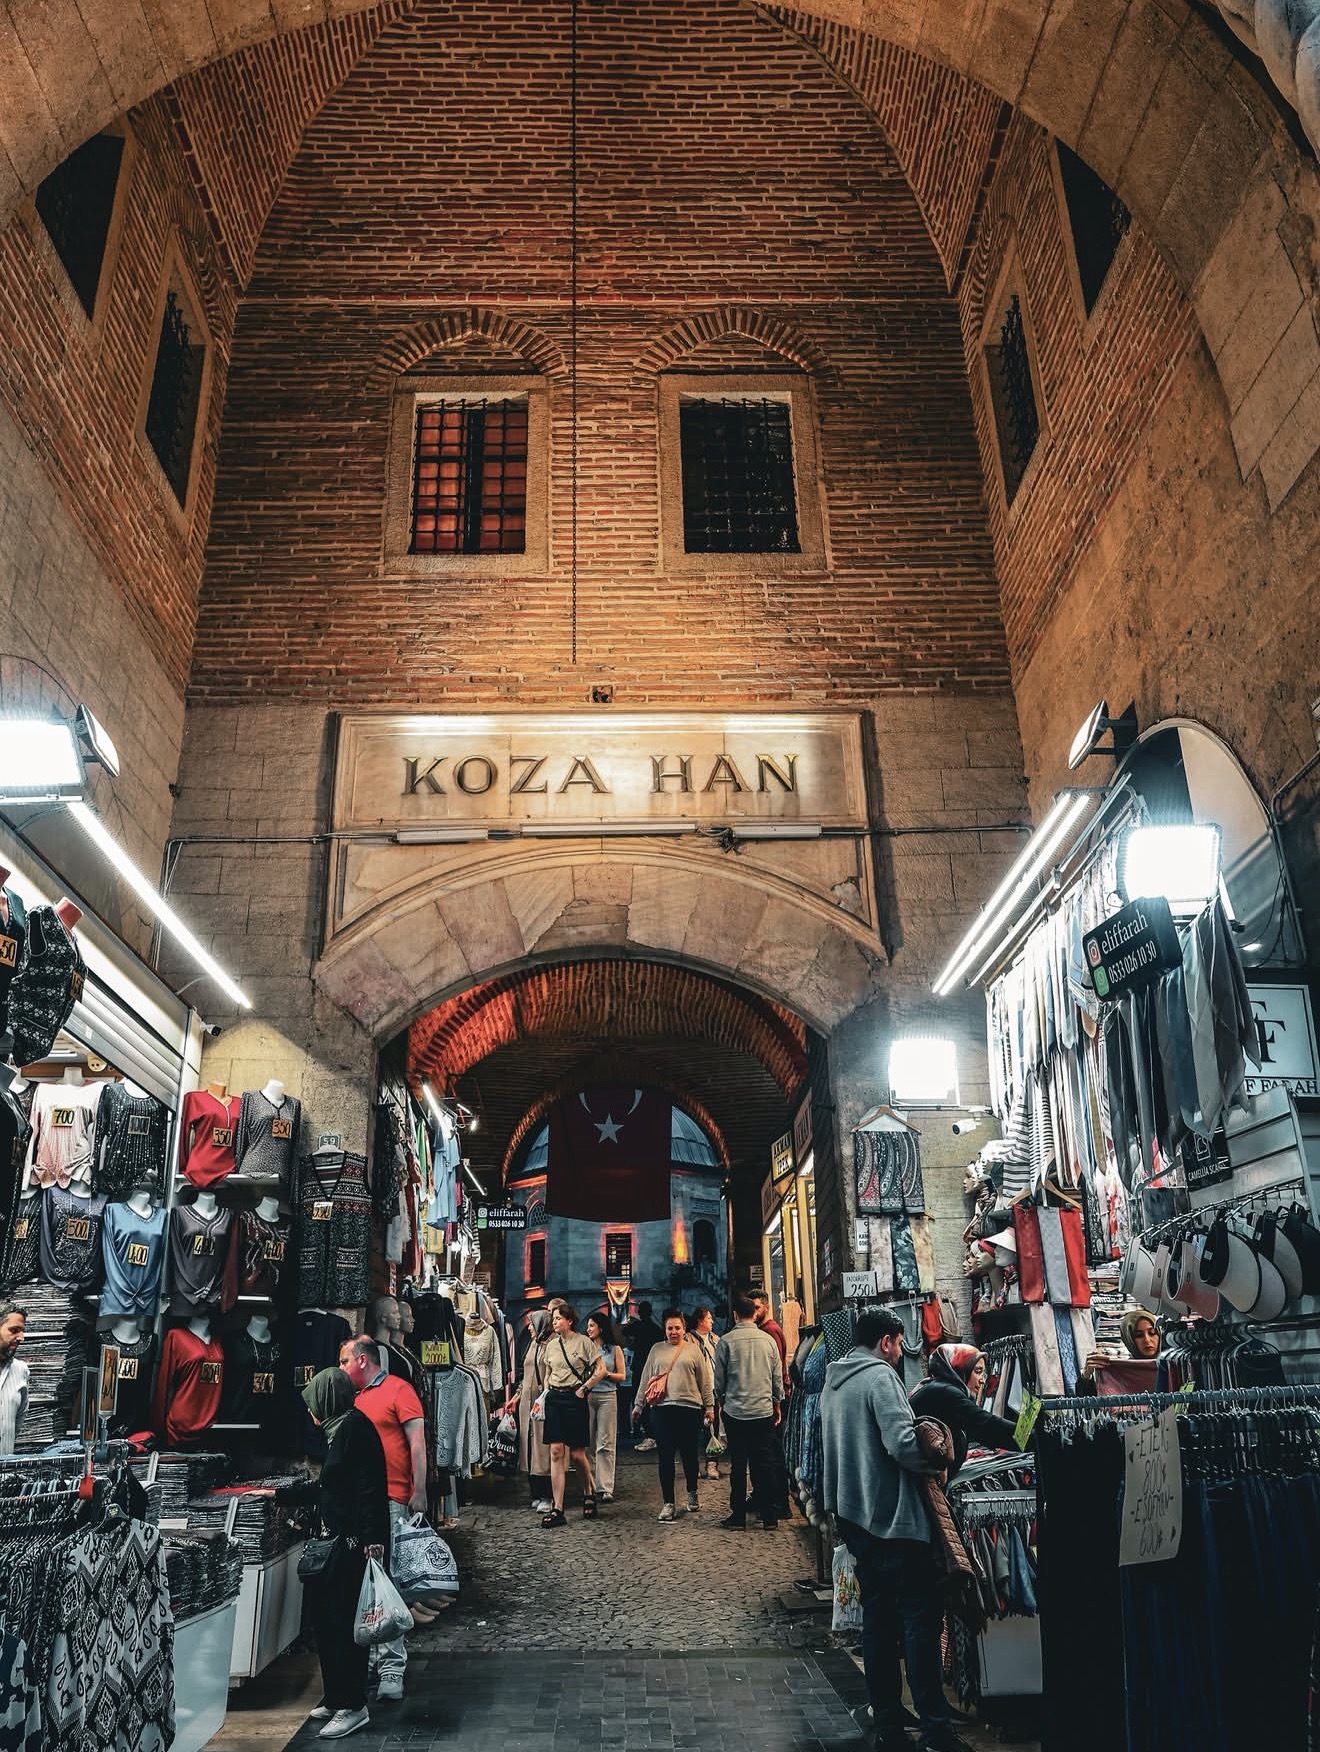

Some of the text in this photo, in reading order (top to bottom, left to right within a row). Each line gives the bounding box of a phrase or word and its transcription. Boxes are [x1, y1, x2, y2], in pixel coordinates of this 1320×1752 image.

[401, 754, 801, 795] KOZA HAN
[1101, 909, 1149, 954] eliffarah
[1108, 940, 1157, 984] 0533 026 10 30
[55, 1109, 75, 1125] 700
[273, 1121, 291, 1136] 350
[214, 1130, 231, 1146] 350
[323, 1137, 337, 1147] 59
[489, 1208, 524, 1217] eliffarah
[489, 1220, 501, 1228] 0533
[511, 1220, 517, 1228] 10
[518, 1220, 525, 1228] 30
